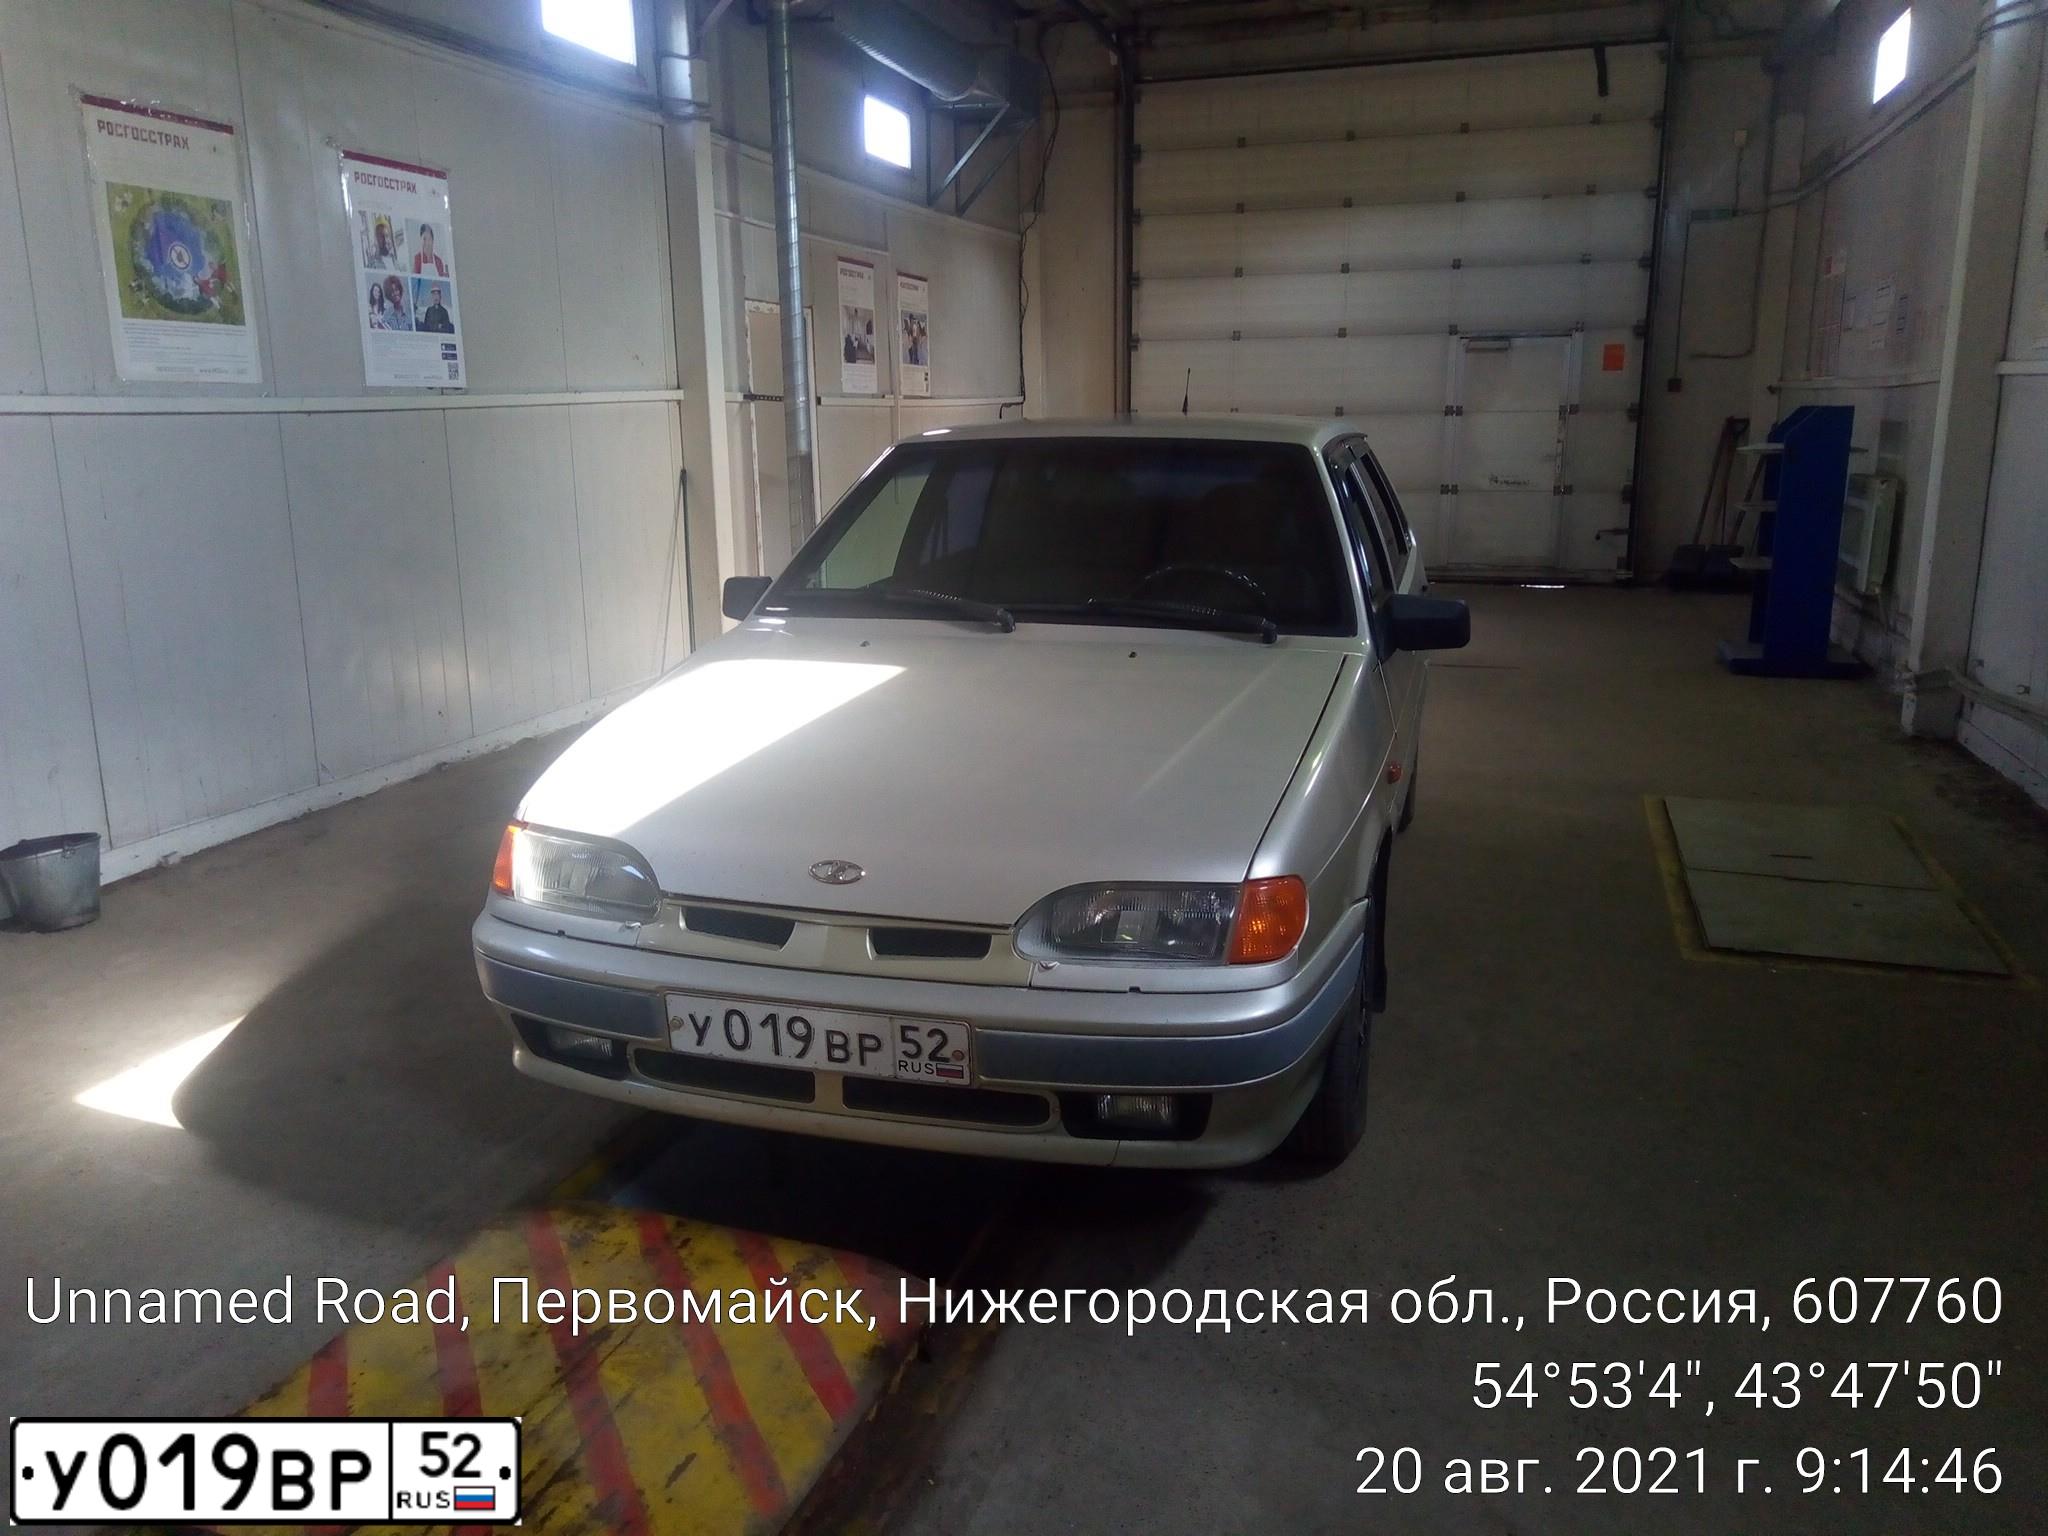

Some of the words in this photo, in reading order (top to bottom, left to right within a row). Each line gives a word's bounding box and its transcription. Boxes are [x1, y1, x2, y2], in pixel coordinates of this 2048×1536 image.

[97, 119, 190, 150] РОСГОССТРАХ
[354, 171, 417, 193] РОСГОССТРАХ
[899, 1024, 951, 1063] 52
[898, 1059, 935, 1075] RUS
